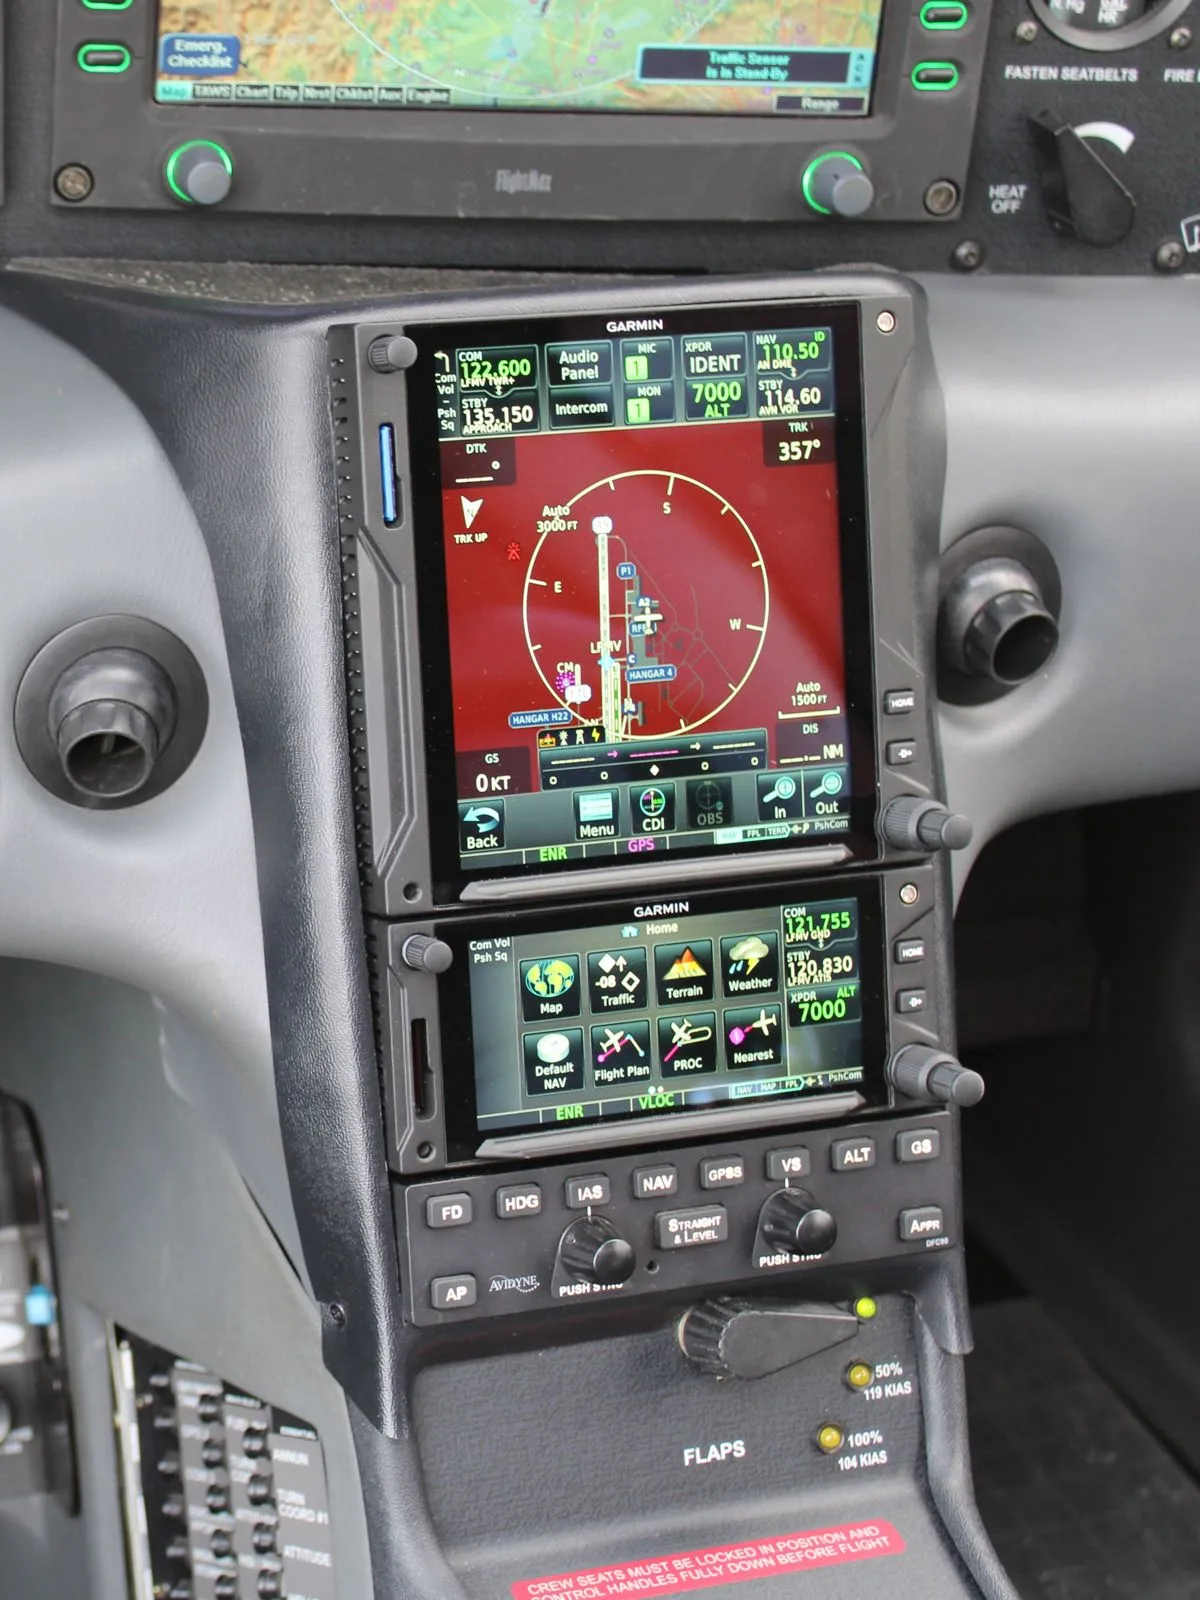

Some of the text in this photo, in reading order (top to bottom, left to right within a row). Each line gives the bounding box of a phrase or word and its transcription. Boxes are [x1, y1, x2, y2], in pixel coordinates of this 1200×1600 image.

[168, 55, 232, 68] Checklist
[1005, 65, 1138, 82] FASTEN SEATBELTS
[1164, 69, 1195, 82] FIRE
[989, 185, 1027, 198] HEAT
[992, 201, 1020, 213] OFF
[606, 319, 663, 333] GARMIN
[638, 343, 657, 353] MIC
[685, 341, 712, 353] XPDR
[560, 351, 599, 364] Audio
[690, 355, 741, 373] IDENT
[460, 359, 531, 379] 122.600
[561, 366, 599, 380] Panel
[638, 387, 661, 397] MON
[692, 381, 741, 403] 7000
[556, 402, 608, 415] Intercom
[704, 403, 731, 418] ALT
[463, 406, 533, 426] 135.150
[463, 423, 512, 434] APPROACH
[466, 443, 487, 454] DTK
[796, 682, 821, 693] Auto
[803, 724, 819, 734] DIS
[775, 806, 786, 819] In
[816, 802, 839, 814] Out
[643, 818, 665, 831] CDI
[697, 813, 723, 826] OBS
[815, 820, 848, 831] PshCom
[580, 824, 615, 838] Menu
[467, 835, 498, 849] Back
[628, 839, 655, 852] GPS
[540, 848, 568, 862] ENR
[634, 902, 689, 918] GARMIN
[646, 924, 678, 936] Home
[729, 977, 773, 992] Weather
[666, 985, 703, 1000] Terrain
[601, 994, 635, 1007] Traffic
[540, 1003, 563, 1015] Map
[799, 999, 846, 1022] 7000
[734, 1049, 774, 1064] Nearest
[535, 1062, 574, 1077] Default
[674, 1057, 703, 1071] PROC
[594, 1066, 649, 1082] Flight Plan
[544, 1077, 567, 1090] NAV
[556, 1105, 584, 1121] ENR
[844, 1146, 870, 1164] ALT
[708, 1166, 743, 1182] GPSS
[643, 1175, 673, 1192] NAV
[578, 1185, 603, 1201] IAS
[505, 1194, 539, 1211] HDG
[442, 1205, 463, 1221] FD
[926, 1237, 948, 1247] DFC90
[445, 1286, 467, 1302] AP
[875, 1362, 902, 1378] 50%
[848, 1430, 882, 1448] 100%
[683, 1440, 746, 1466] FLAPS
[528, 1525, 880, 1595] CREW SEATS MUST BE LOCKED IN POSITION AND
[607, 1573, 678, 1595] HANDLES
[680, 1566, 722, 1582] FULLY
[728, 1556, 775, 1575] DOWN
[779, 1548, 838, 1566] BEFORE
[840, 1536, 890, 1554] FLIGHT
